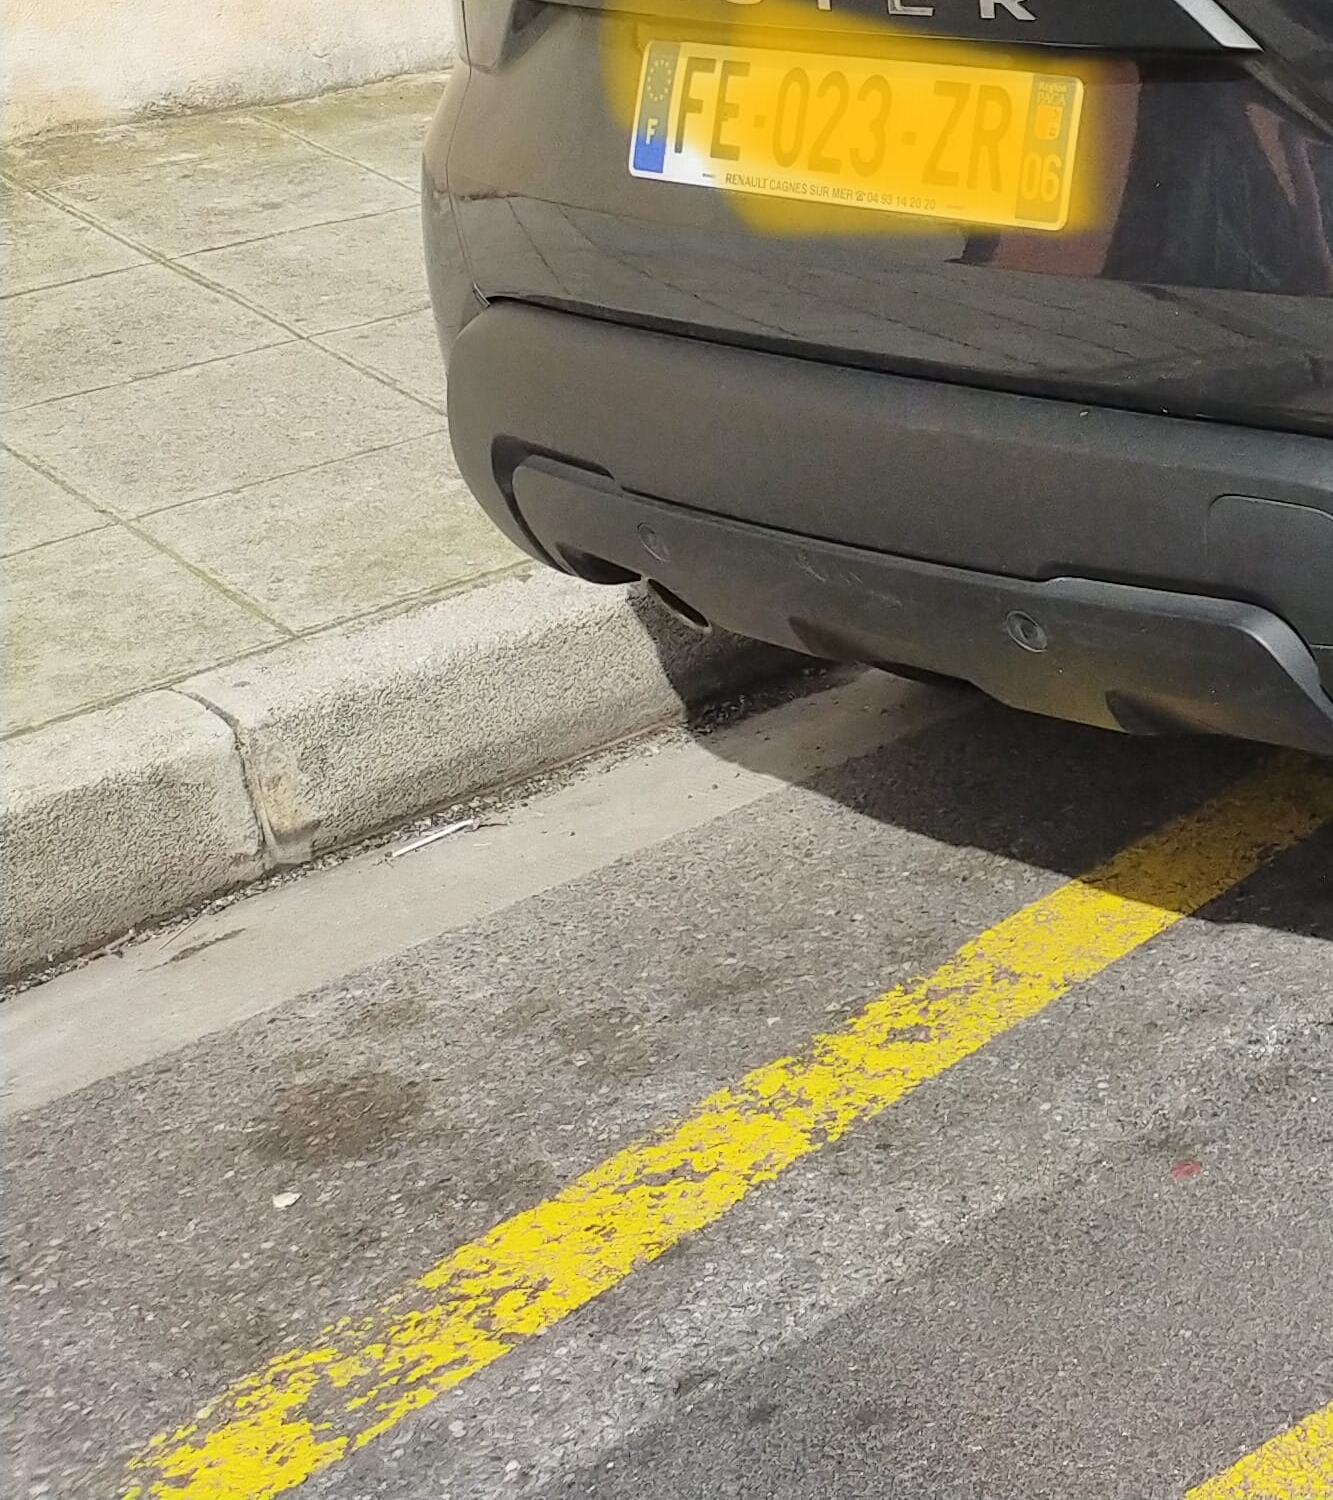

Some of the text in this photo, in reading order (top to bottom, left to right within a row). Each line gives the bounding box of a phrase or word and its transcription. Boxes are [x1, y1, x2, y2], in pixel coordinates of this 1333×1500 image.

[645, 56, 1012, 193] F FE-023-ZR
[726, 172, 936, 210] RENAULT CAGNES SUR MER 04 93 14 20 20
[1019, 152, 1062, 203] 06
